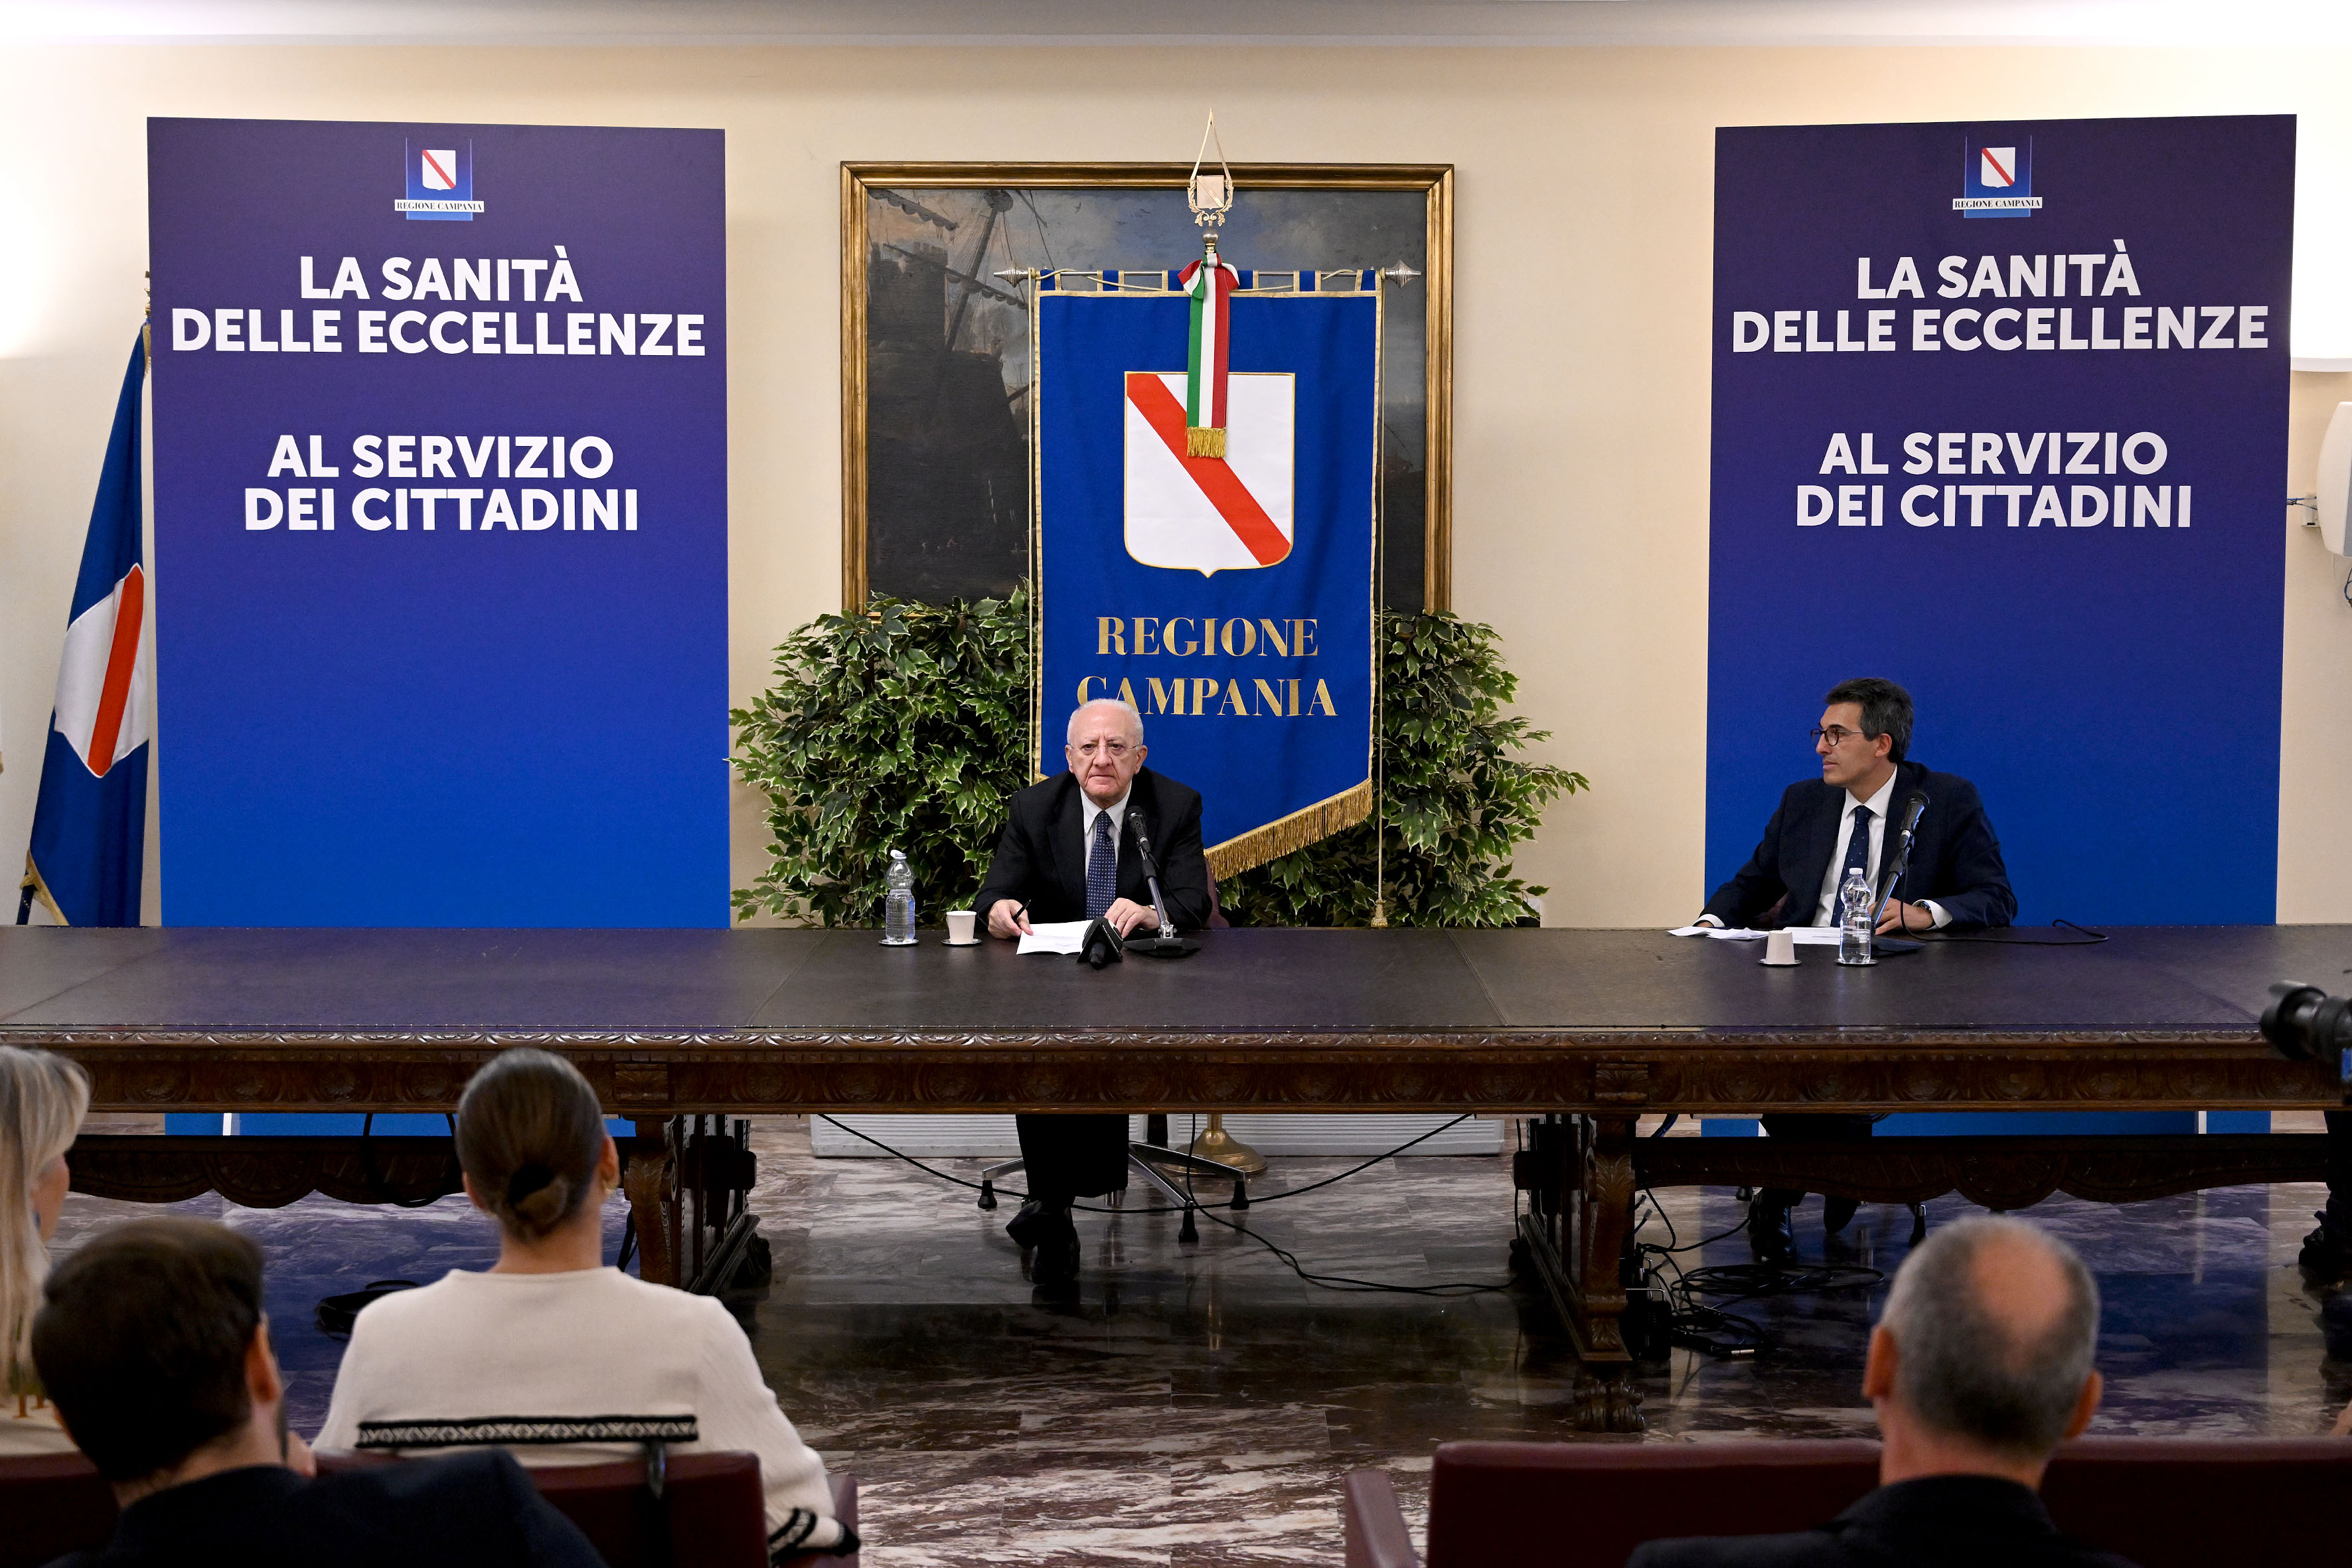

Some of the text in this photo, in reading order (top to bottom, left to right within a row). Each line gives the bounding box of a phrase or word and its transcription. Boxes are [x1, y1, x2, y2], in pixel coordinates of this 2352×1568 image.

[300, 245, 584, 302] LA SANITÀ
[1857, 238, 2142, 299] LA SANITÀ
[172, 308, 706, 356] DELLE ECCELLENZE
[1733, 305, 2269, 353] DELLE ECCELLENZE
[267, 434, 614, 479] AL SERVIZIO
[1818, 431, 2168, 475] AL SERVIZIO
[245, 488, 638, 531] DEI CITTADINI
[1796, 485, 2191, 528] DEI CITTADINI
[1095, 617, 1318, 657] REGIONE
